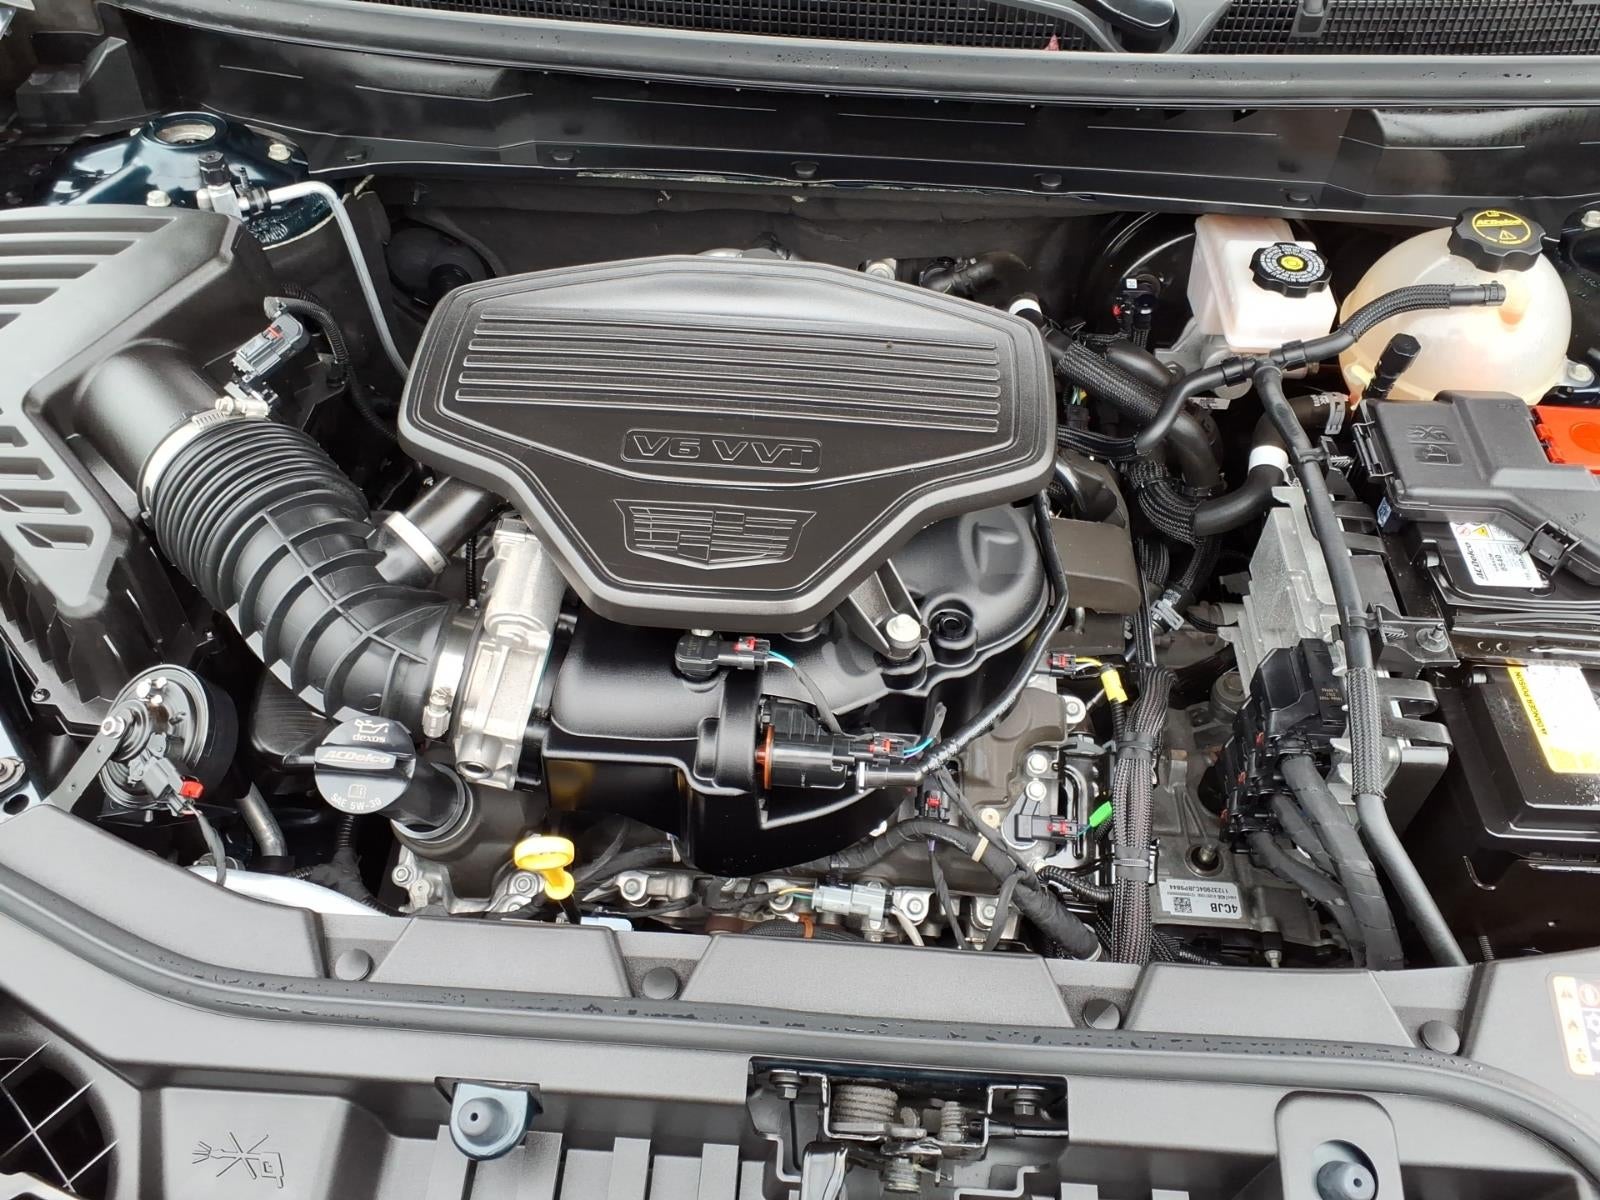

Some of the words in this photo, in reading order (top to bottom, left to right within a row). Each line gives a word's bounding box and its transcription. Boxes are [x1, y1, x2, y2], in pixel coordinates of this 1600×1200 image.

[633, 435, 701, 459] V6
[712, 439, 814, 466] VVT
[352, 733, 386, 743] dexos
[323, 750, 391, 764] ACDelco
[330, 793, 348, 808] SAE
[1210, 902, 1238, 914] 4CJB
